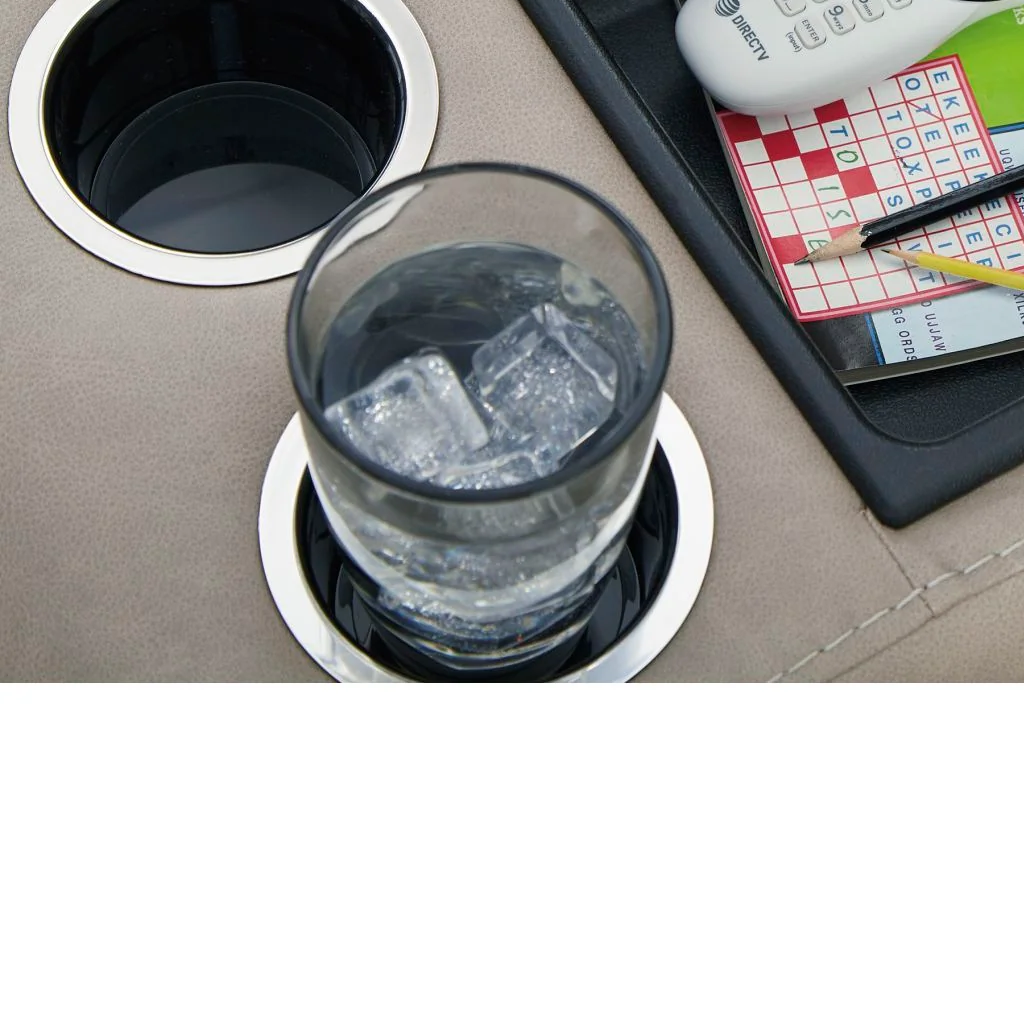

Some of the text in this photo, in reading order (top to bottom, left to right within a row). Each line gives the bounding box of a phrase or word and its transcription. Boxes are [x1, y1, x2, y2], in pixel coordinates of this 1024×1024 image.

[732, 14, 769, 61] DIRECTV
[802, 19, 819, 42] ENTER
[887, 111, 902, 123] T
[916, 186, 932, 200] P
[925, 129, 941, 142] E
[966, 231, 983, 244] E
[933, 71, 949, 84] E
[943, 96, 960, 110] K
[953, 122, 970, 135] E
[963, 147, 980, 160] E
[995, 224, 1011, 237] C
[887, 195, 903, 207] S
[919, 273, 935, 285] T
[925, 312, 946, 351] UJJAW
